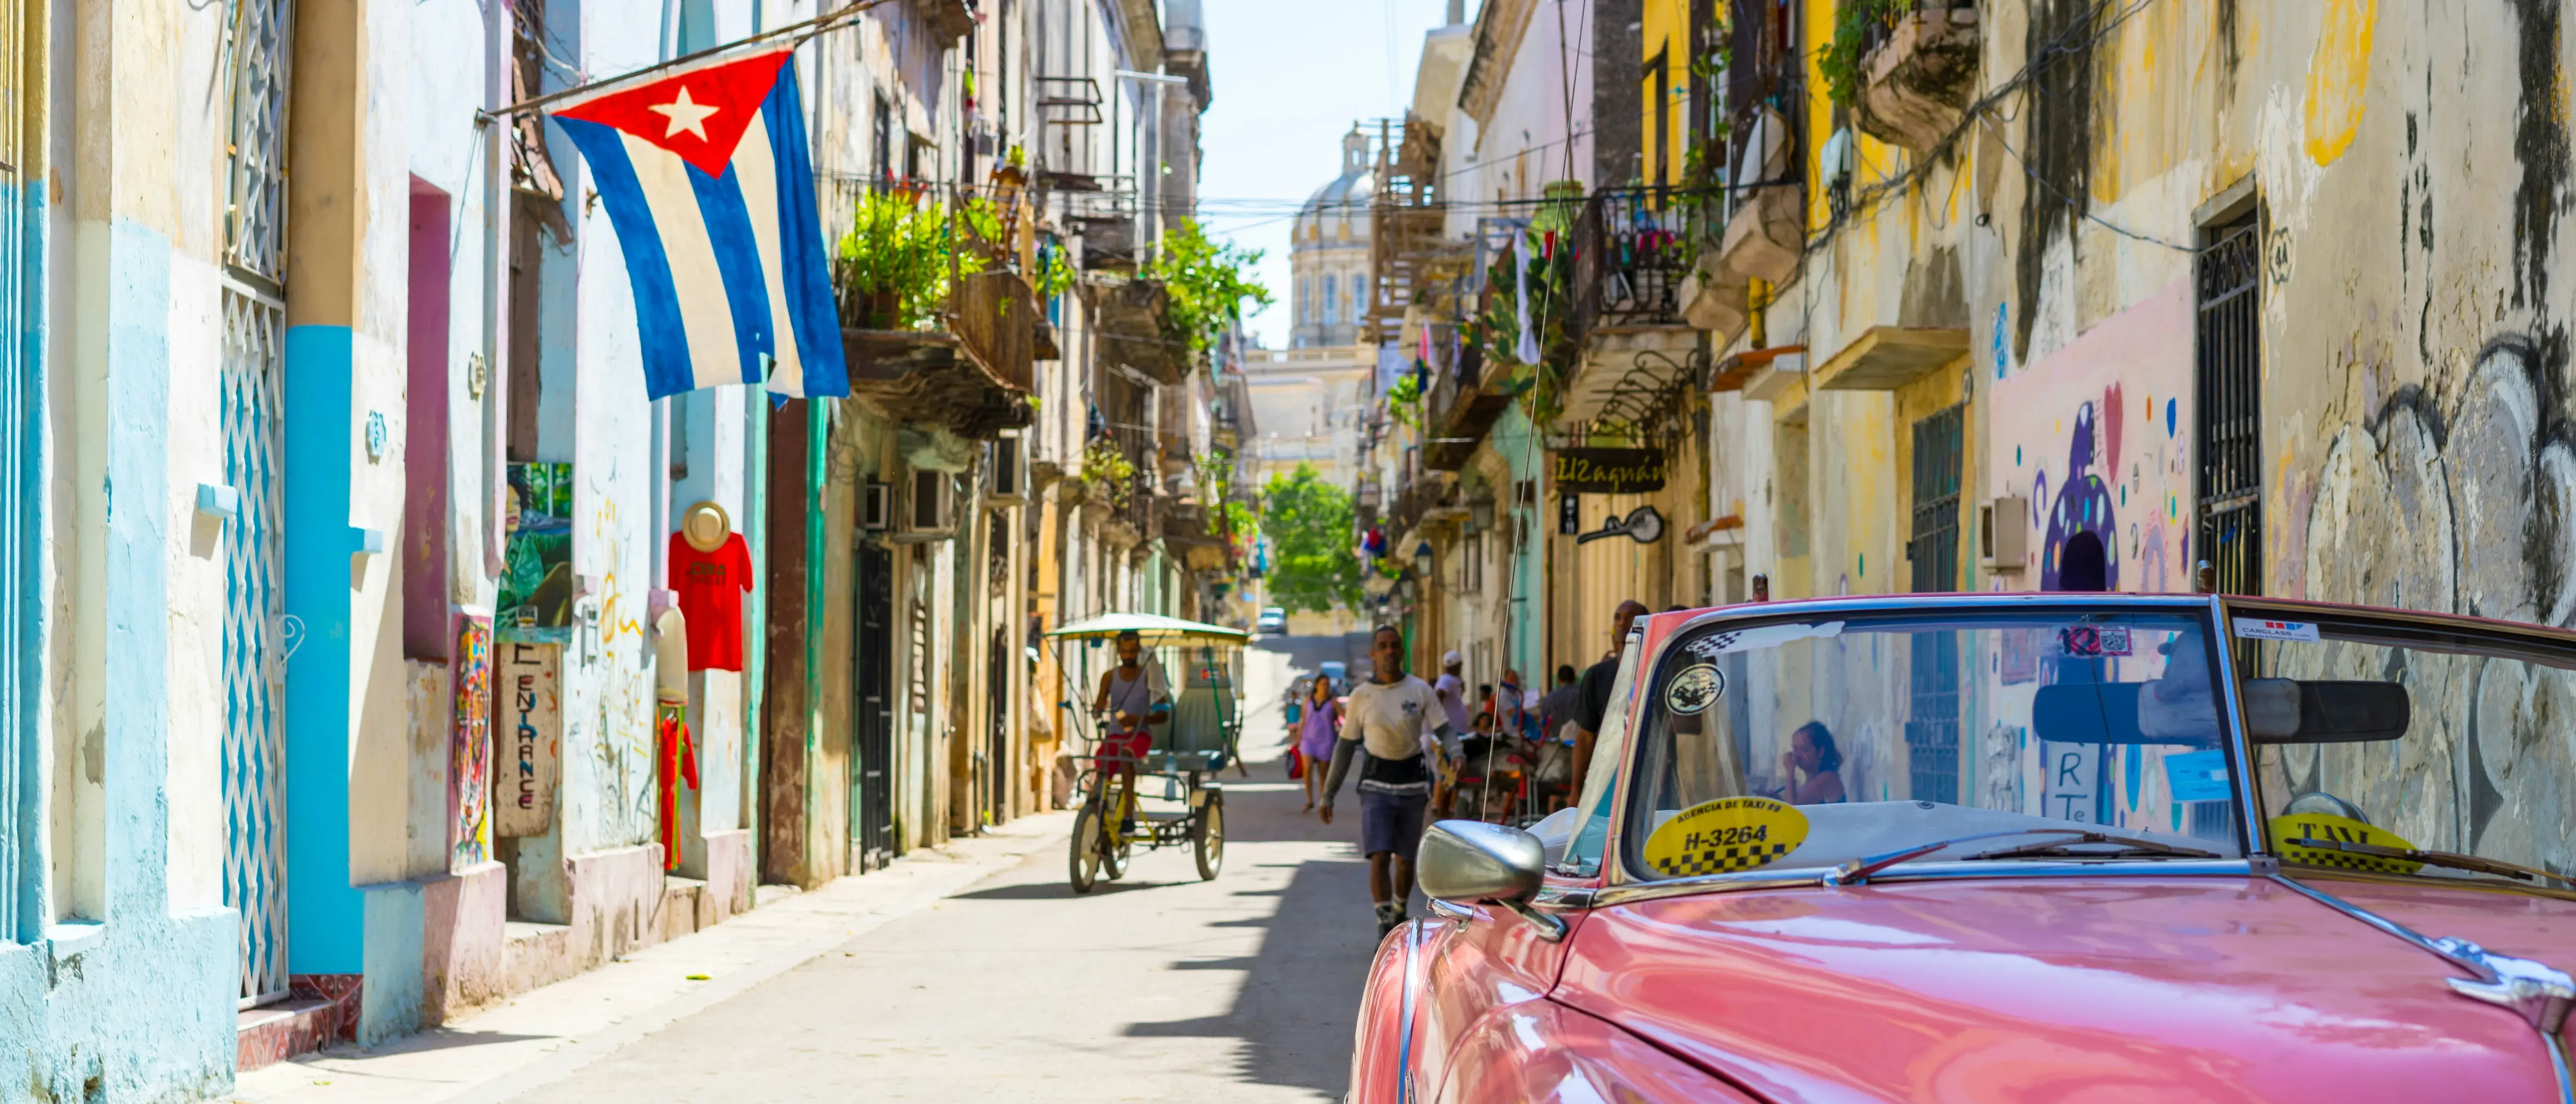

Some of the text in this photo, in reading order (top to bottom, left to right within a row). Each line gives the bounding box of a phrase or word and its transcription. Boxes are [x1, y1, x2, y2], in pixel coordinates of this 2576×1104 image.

[690, 561, 725, 577] CUBA
[2242, 628, 2292, 636] CARGLASS
[1677, 800, 1722, 824] AGENCIA
[1725, 800, 1738, 809] DE
[1742, 800, 1766, 809] TAXI
[1683, 824, 1768, 851] H-3264
